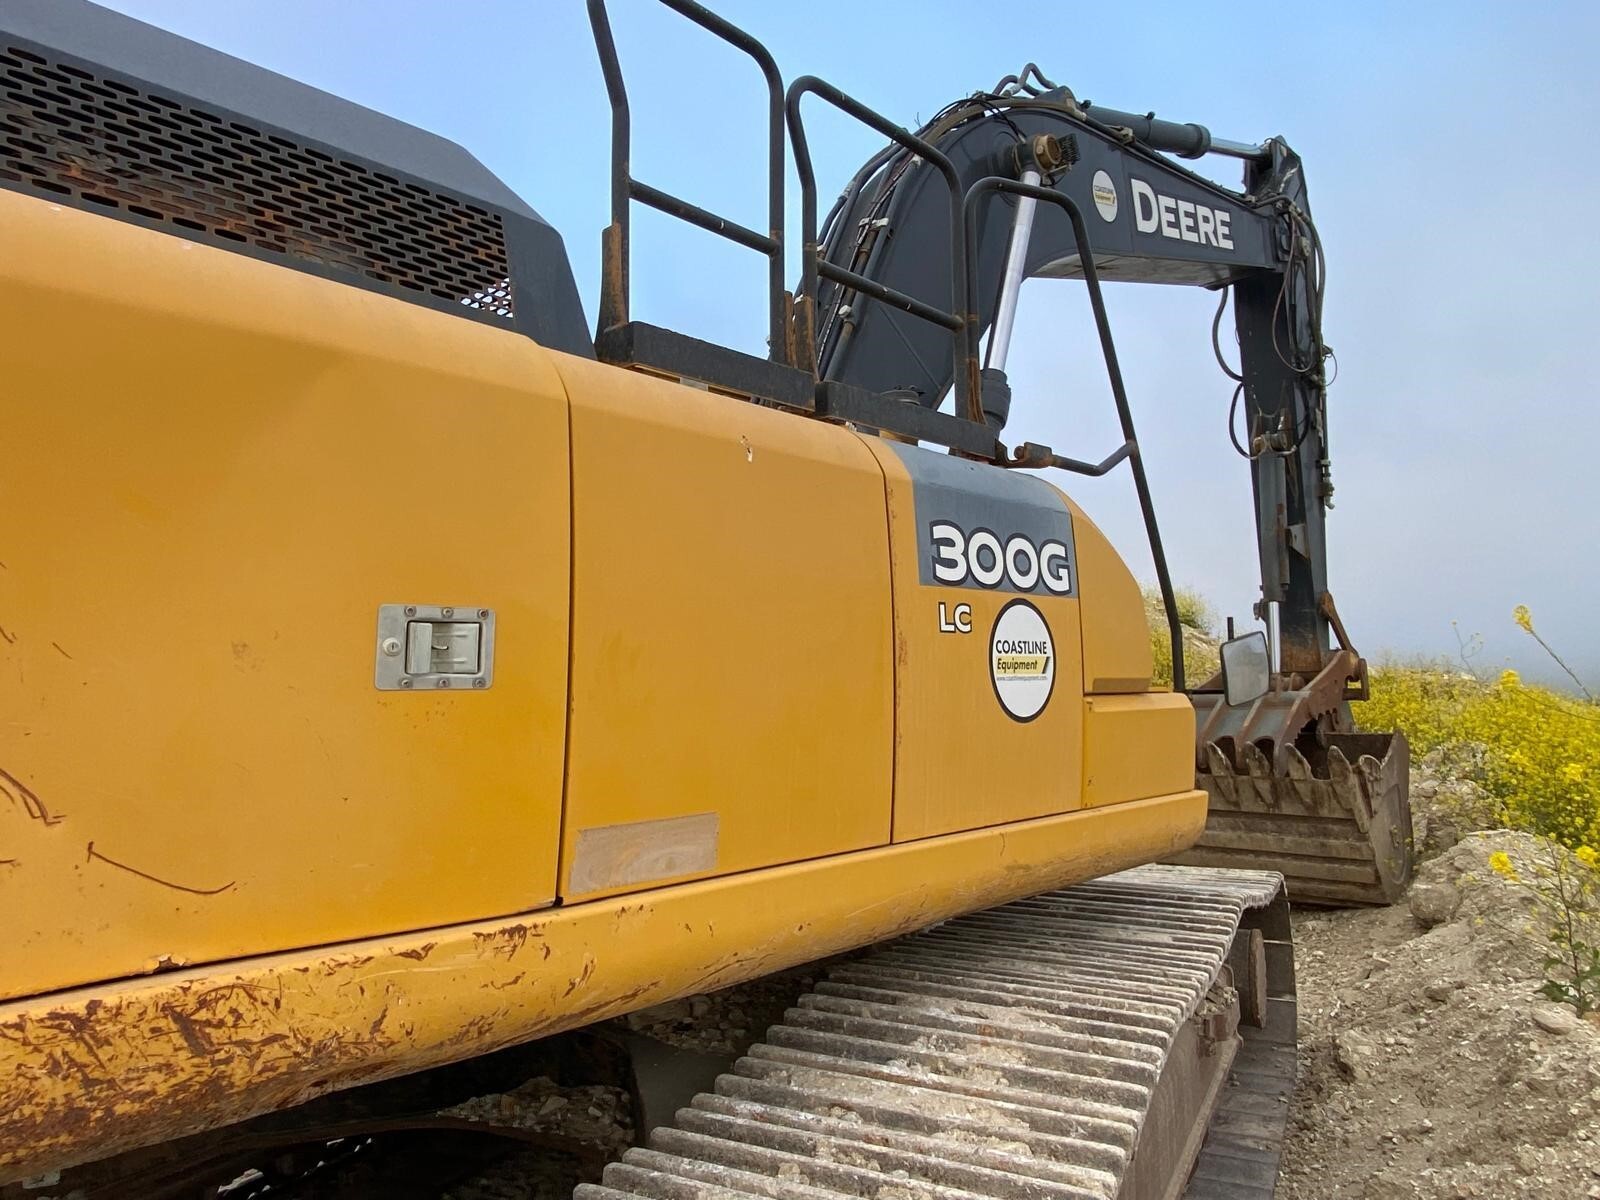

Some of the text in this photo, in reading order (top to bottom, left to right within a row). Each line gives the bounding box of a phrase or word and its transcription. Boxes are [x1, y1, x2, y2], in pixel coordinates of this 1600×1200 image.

[1131, 178, 1234, 250] DEERE
[930, 520, 1072, 595] 300G
[938, 602, 972, 633] LC
[995, 639, 1048, 655] COASTLINE
[997, 657, 1038, 673] Equipment
